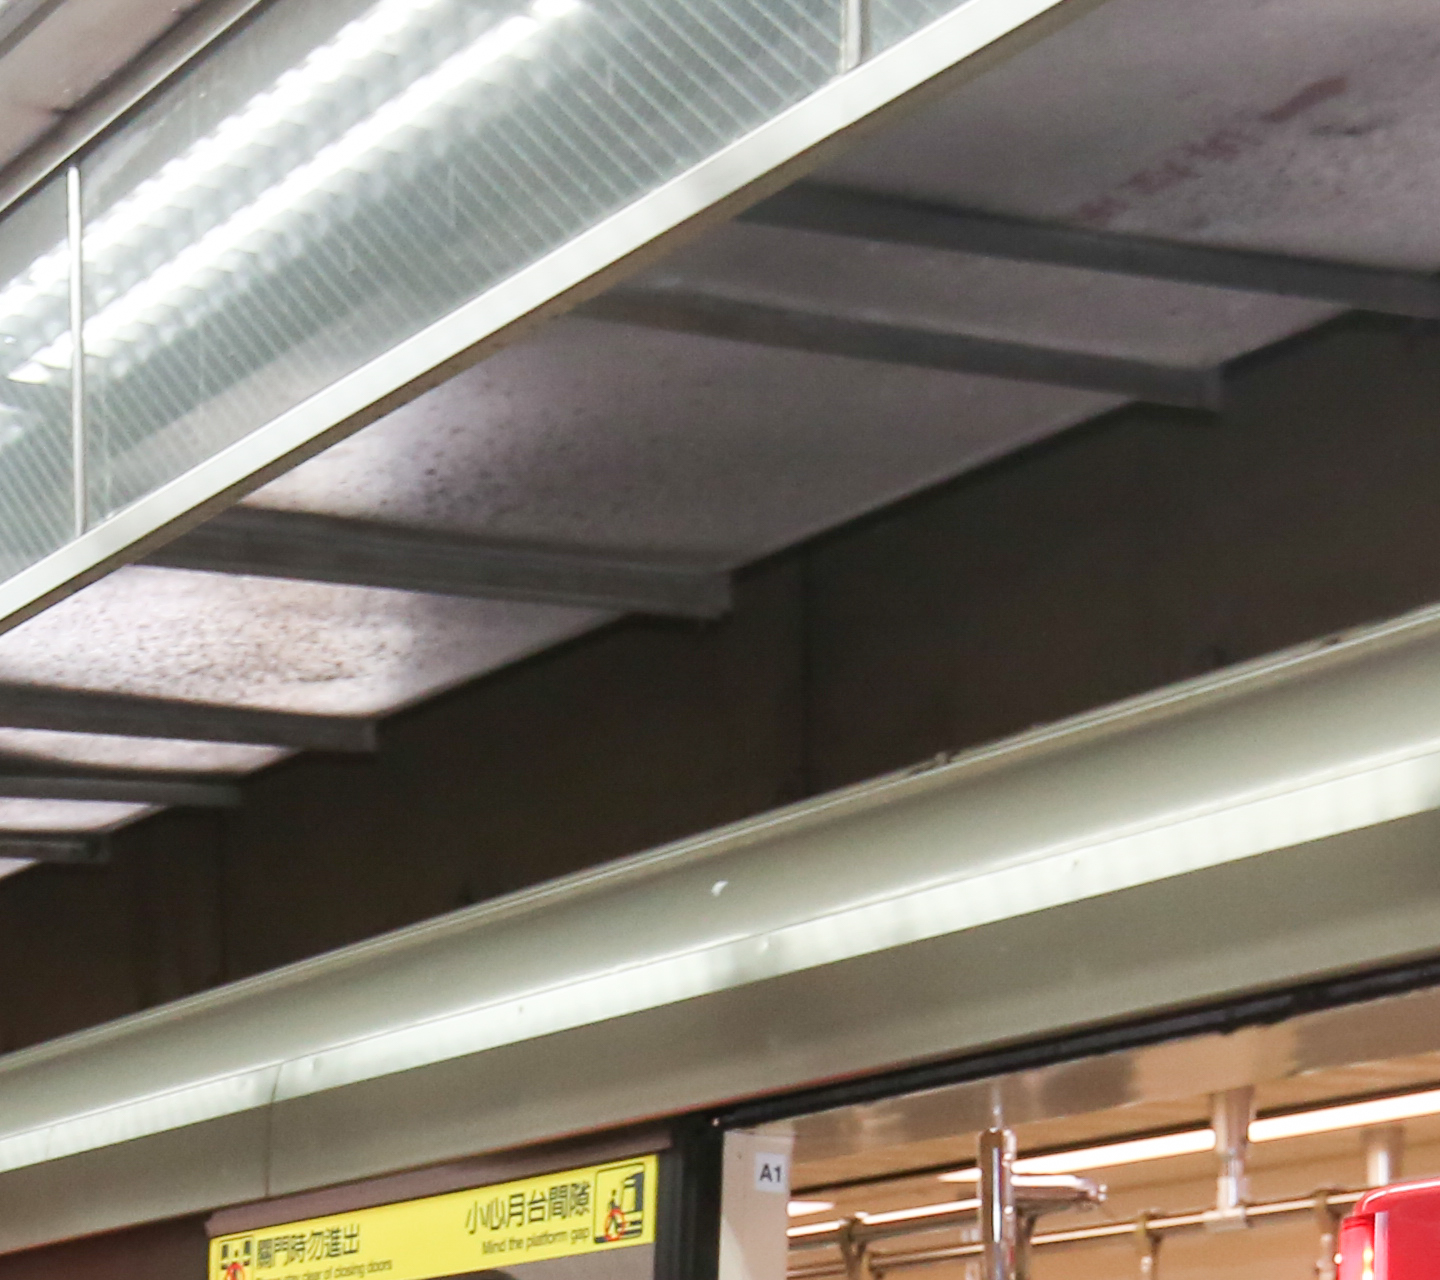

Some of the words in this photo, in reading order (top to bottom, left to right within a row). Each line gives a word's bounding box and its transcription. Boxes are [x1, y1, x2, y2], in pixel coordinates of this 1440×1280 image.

[759, 1163, 781, 1183] A1
[465, 1180, 591, 1235] 小心月台間隙
[482, 1240, 505, 1254] Mind
[508, 1237, 524, 1250] the
[526, 1231, 567, 1250] platform
[570, 1228, 590, 1245] gap
